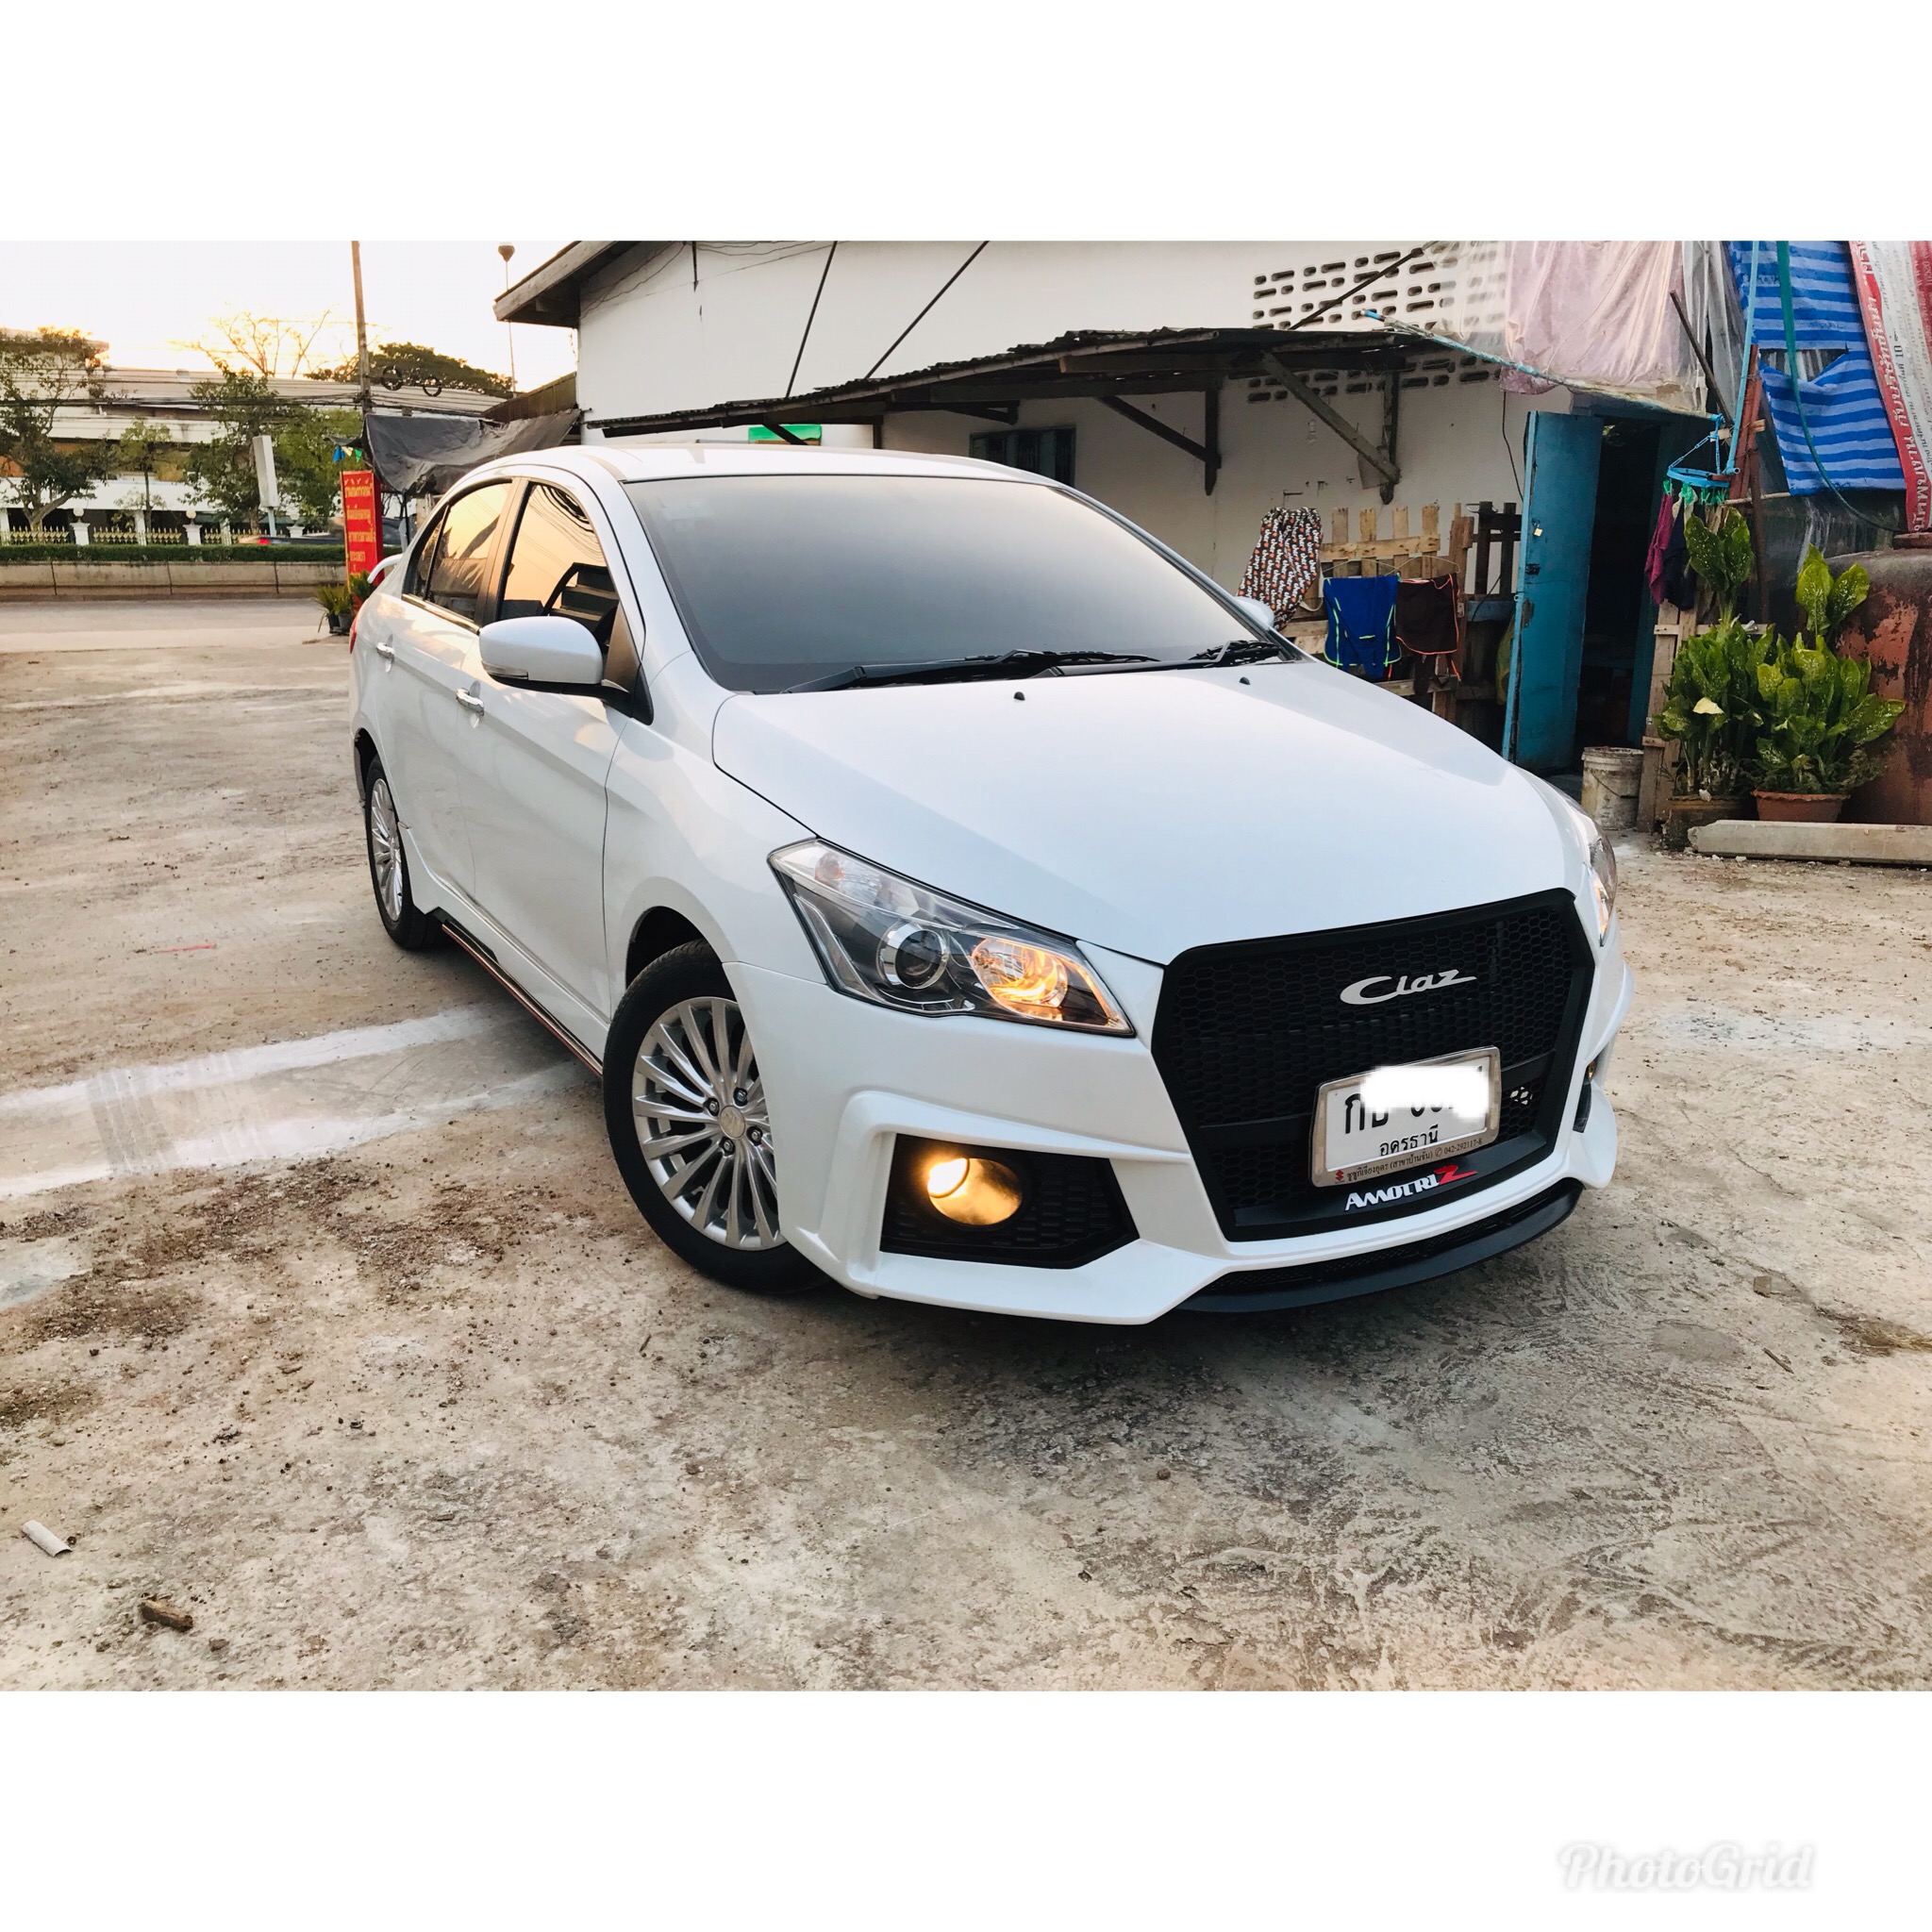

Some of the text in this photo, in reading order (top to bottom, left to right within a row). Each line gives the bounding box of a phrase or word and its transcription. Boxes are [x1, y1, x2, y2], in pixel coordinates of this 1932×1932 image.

[1904, 435, 1928, 531] นัดพบงาน
[1379, 1124, 1440, 1156] อดรธานี
